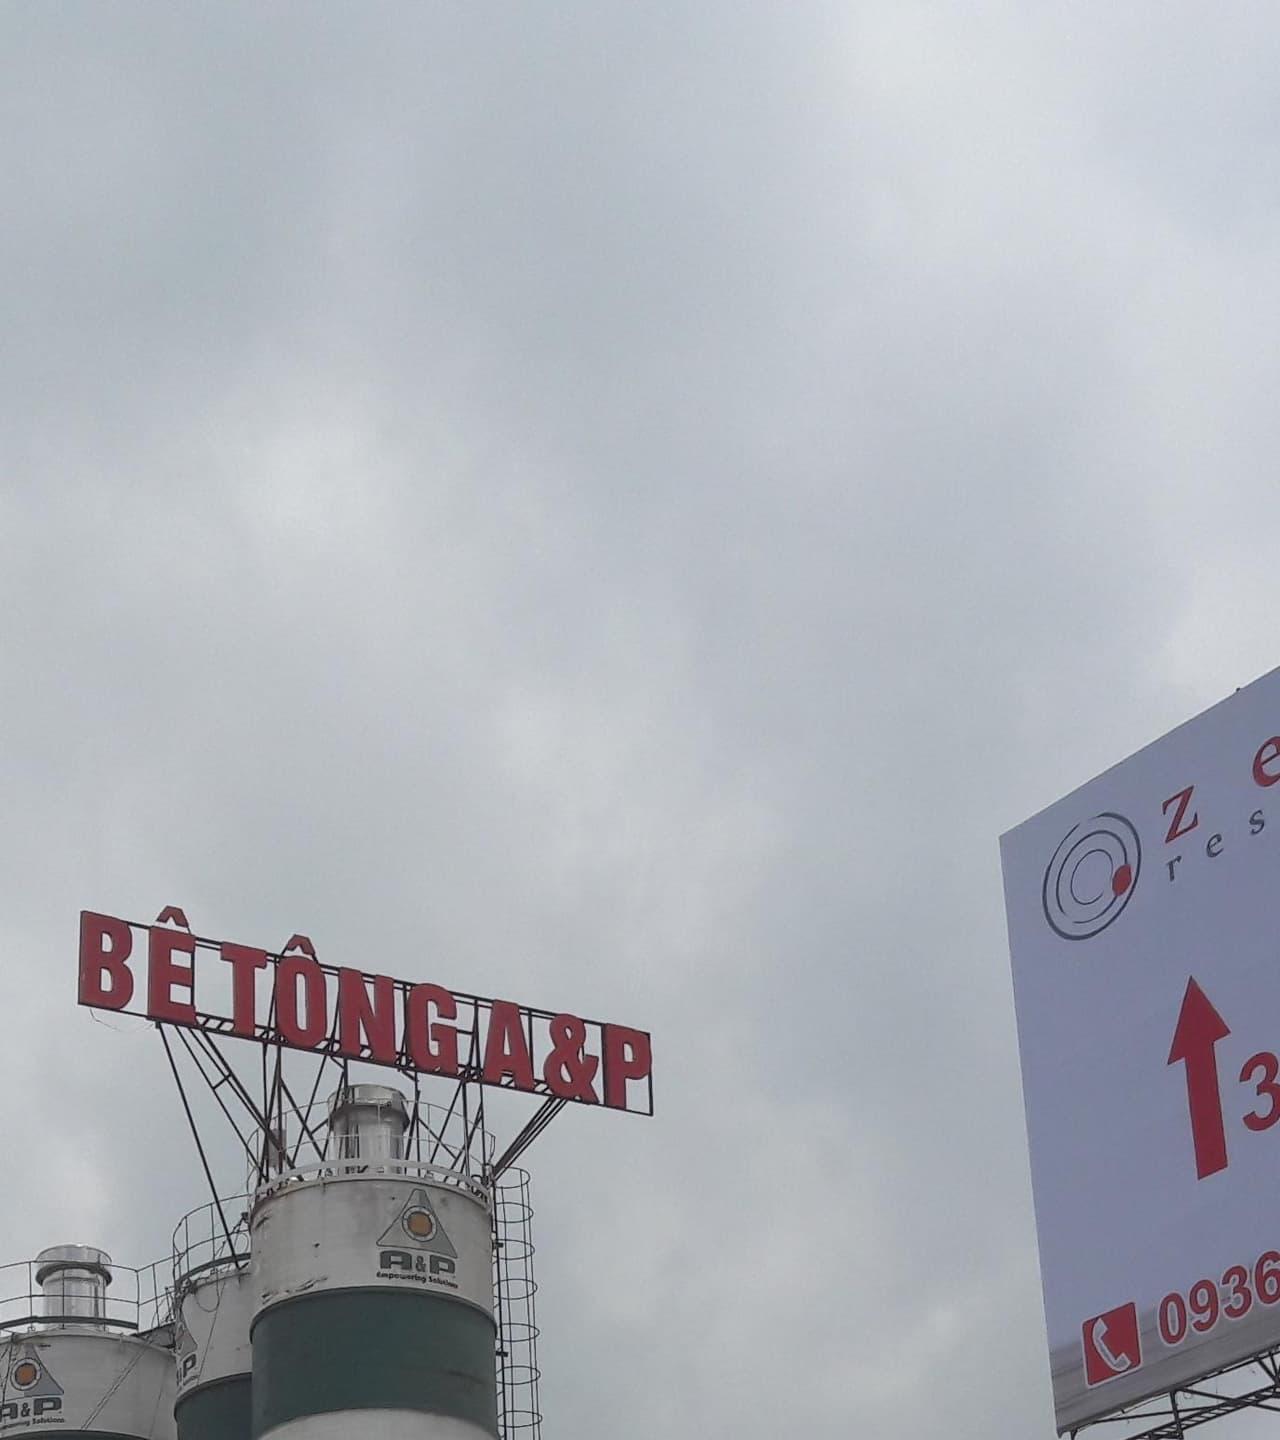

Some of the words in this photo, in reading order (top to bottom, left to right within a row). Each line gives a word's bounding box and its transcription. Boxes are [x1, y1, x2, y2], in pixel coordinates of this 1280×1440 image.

[78, 905, 197, 1028] BÊ
[220, 934, 460, 1077] TÔNG
[482, 998, 652, 1110] A&P
[380, 1250, 455, 1275] A&P
